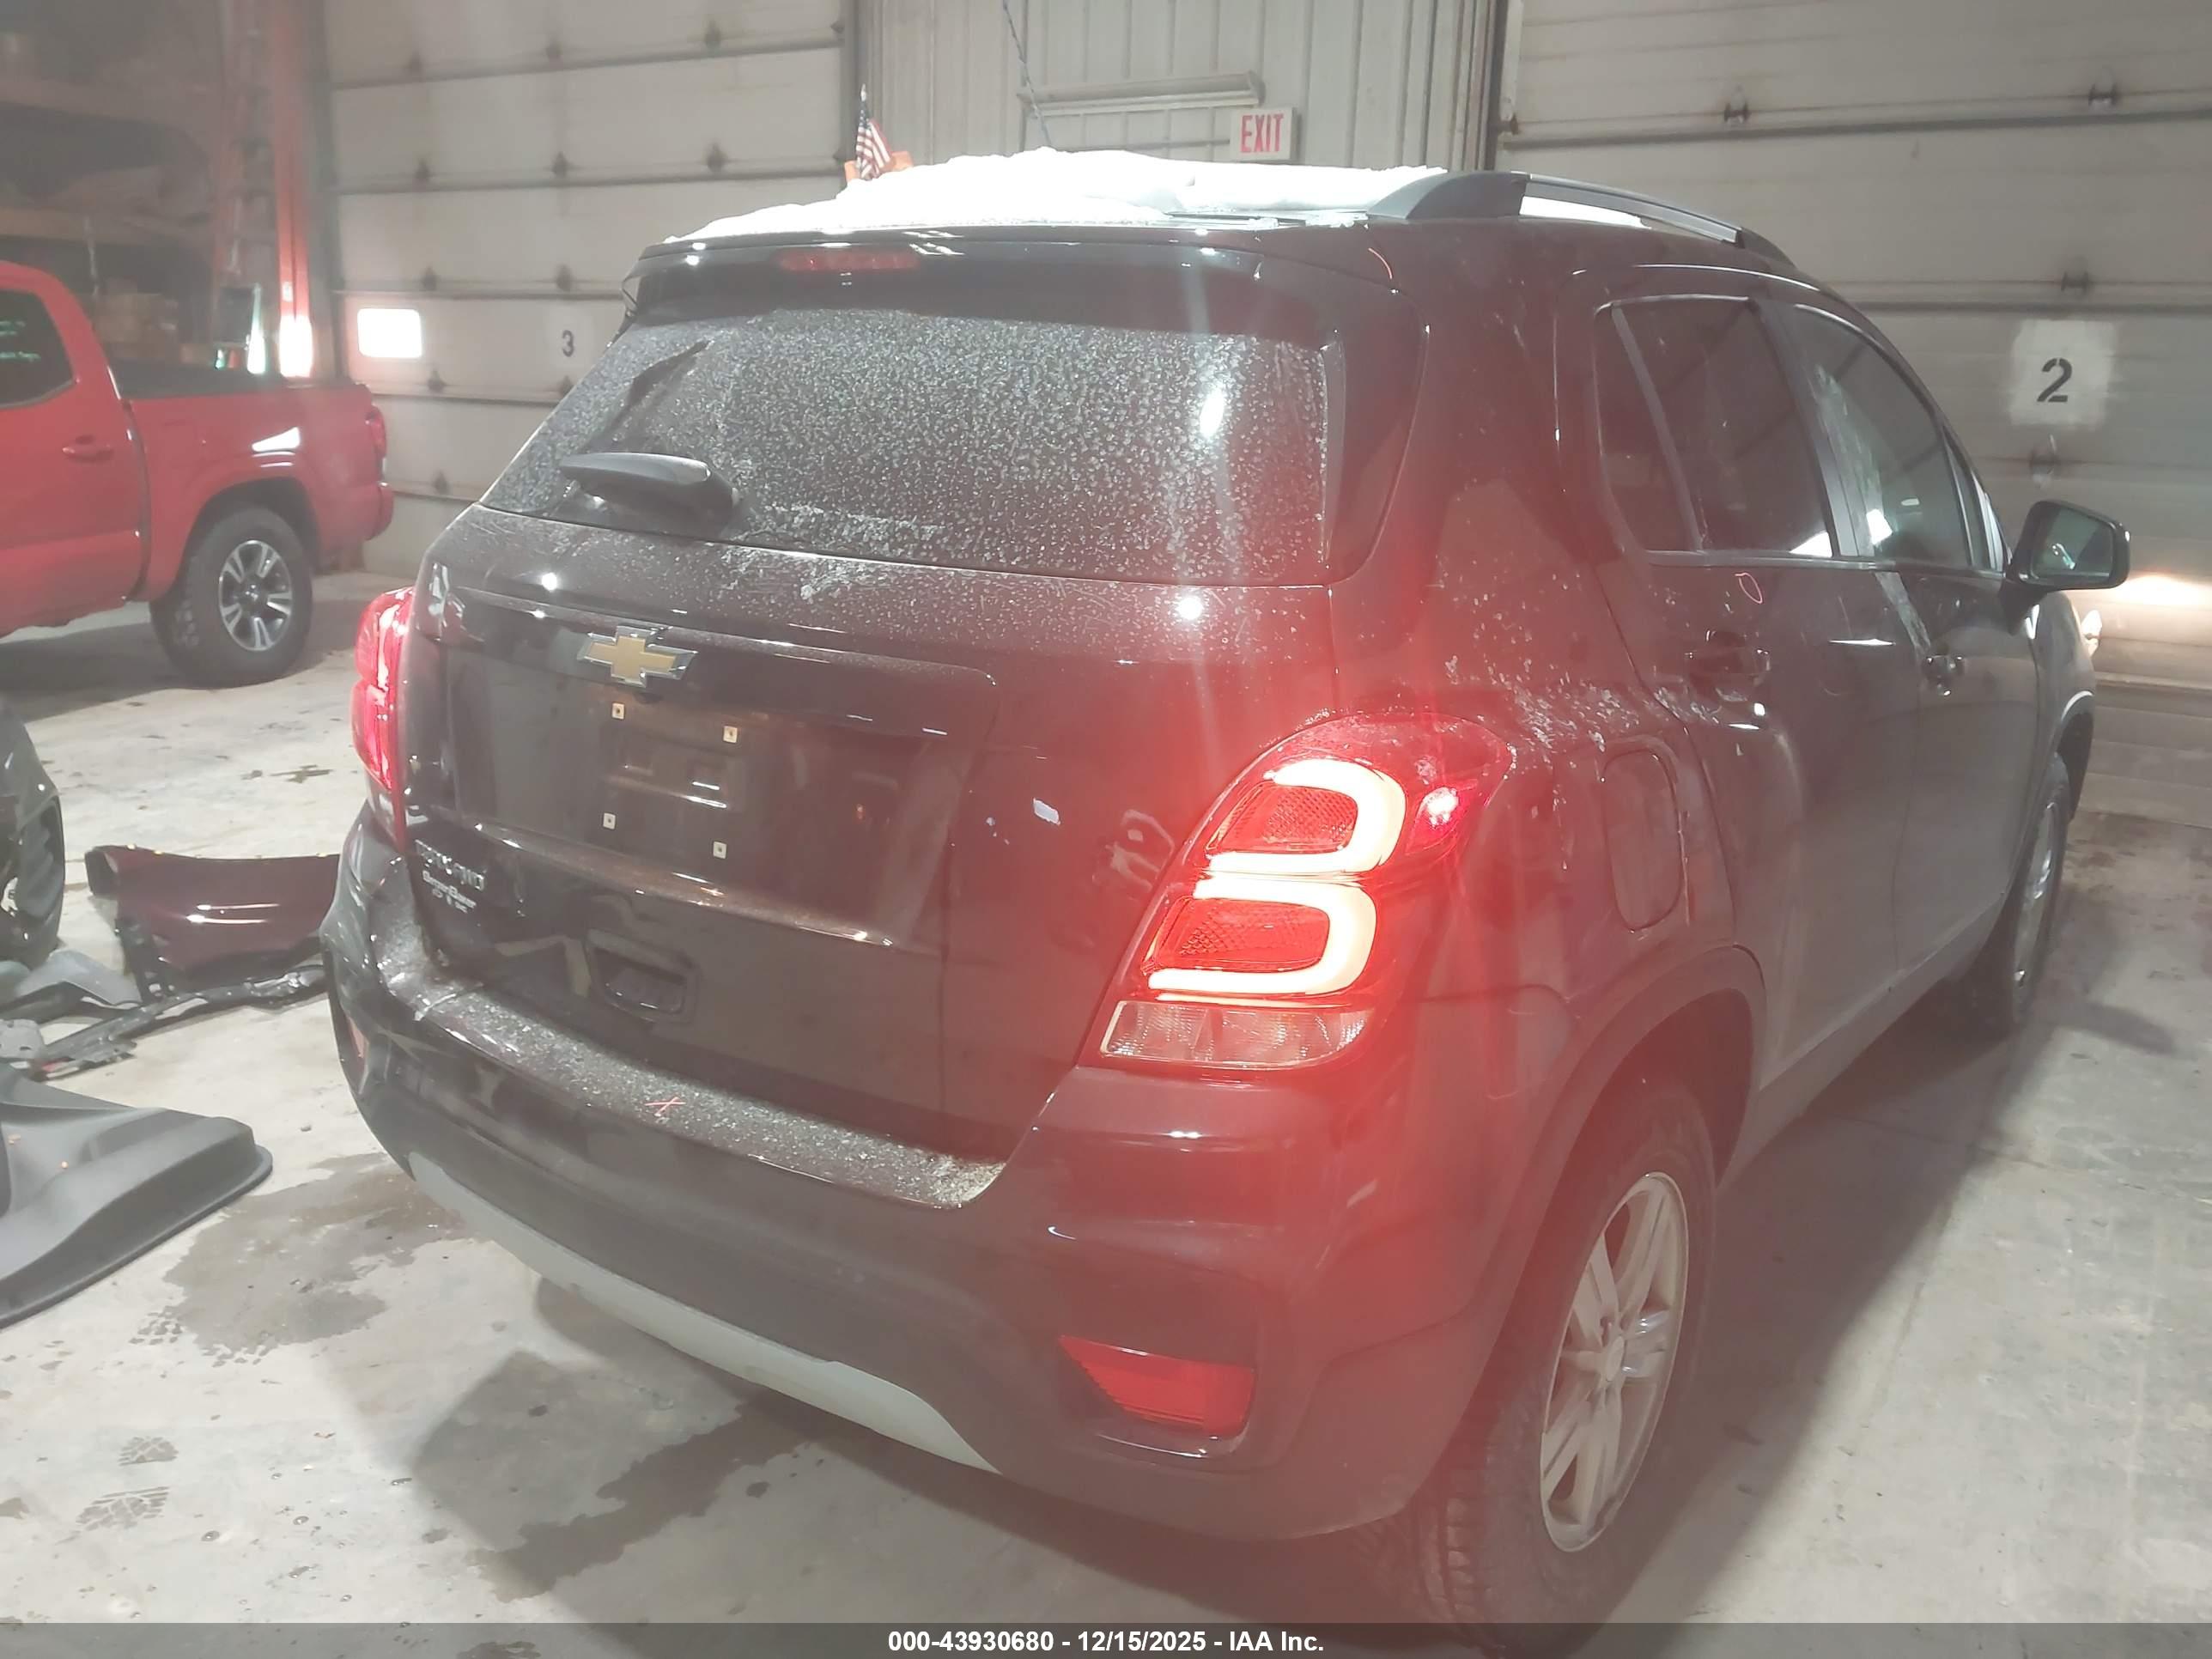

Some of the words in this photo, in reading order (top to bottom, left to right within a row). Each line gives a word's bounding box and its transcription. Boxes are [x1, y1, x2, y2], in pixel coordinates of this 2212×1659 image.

[1241, 113, 1284, 153] EXIT
[562, 329, 574, 357] 3
[2036, 357, 2073, 403] 2
